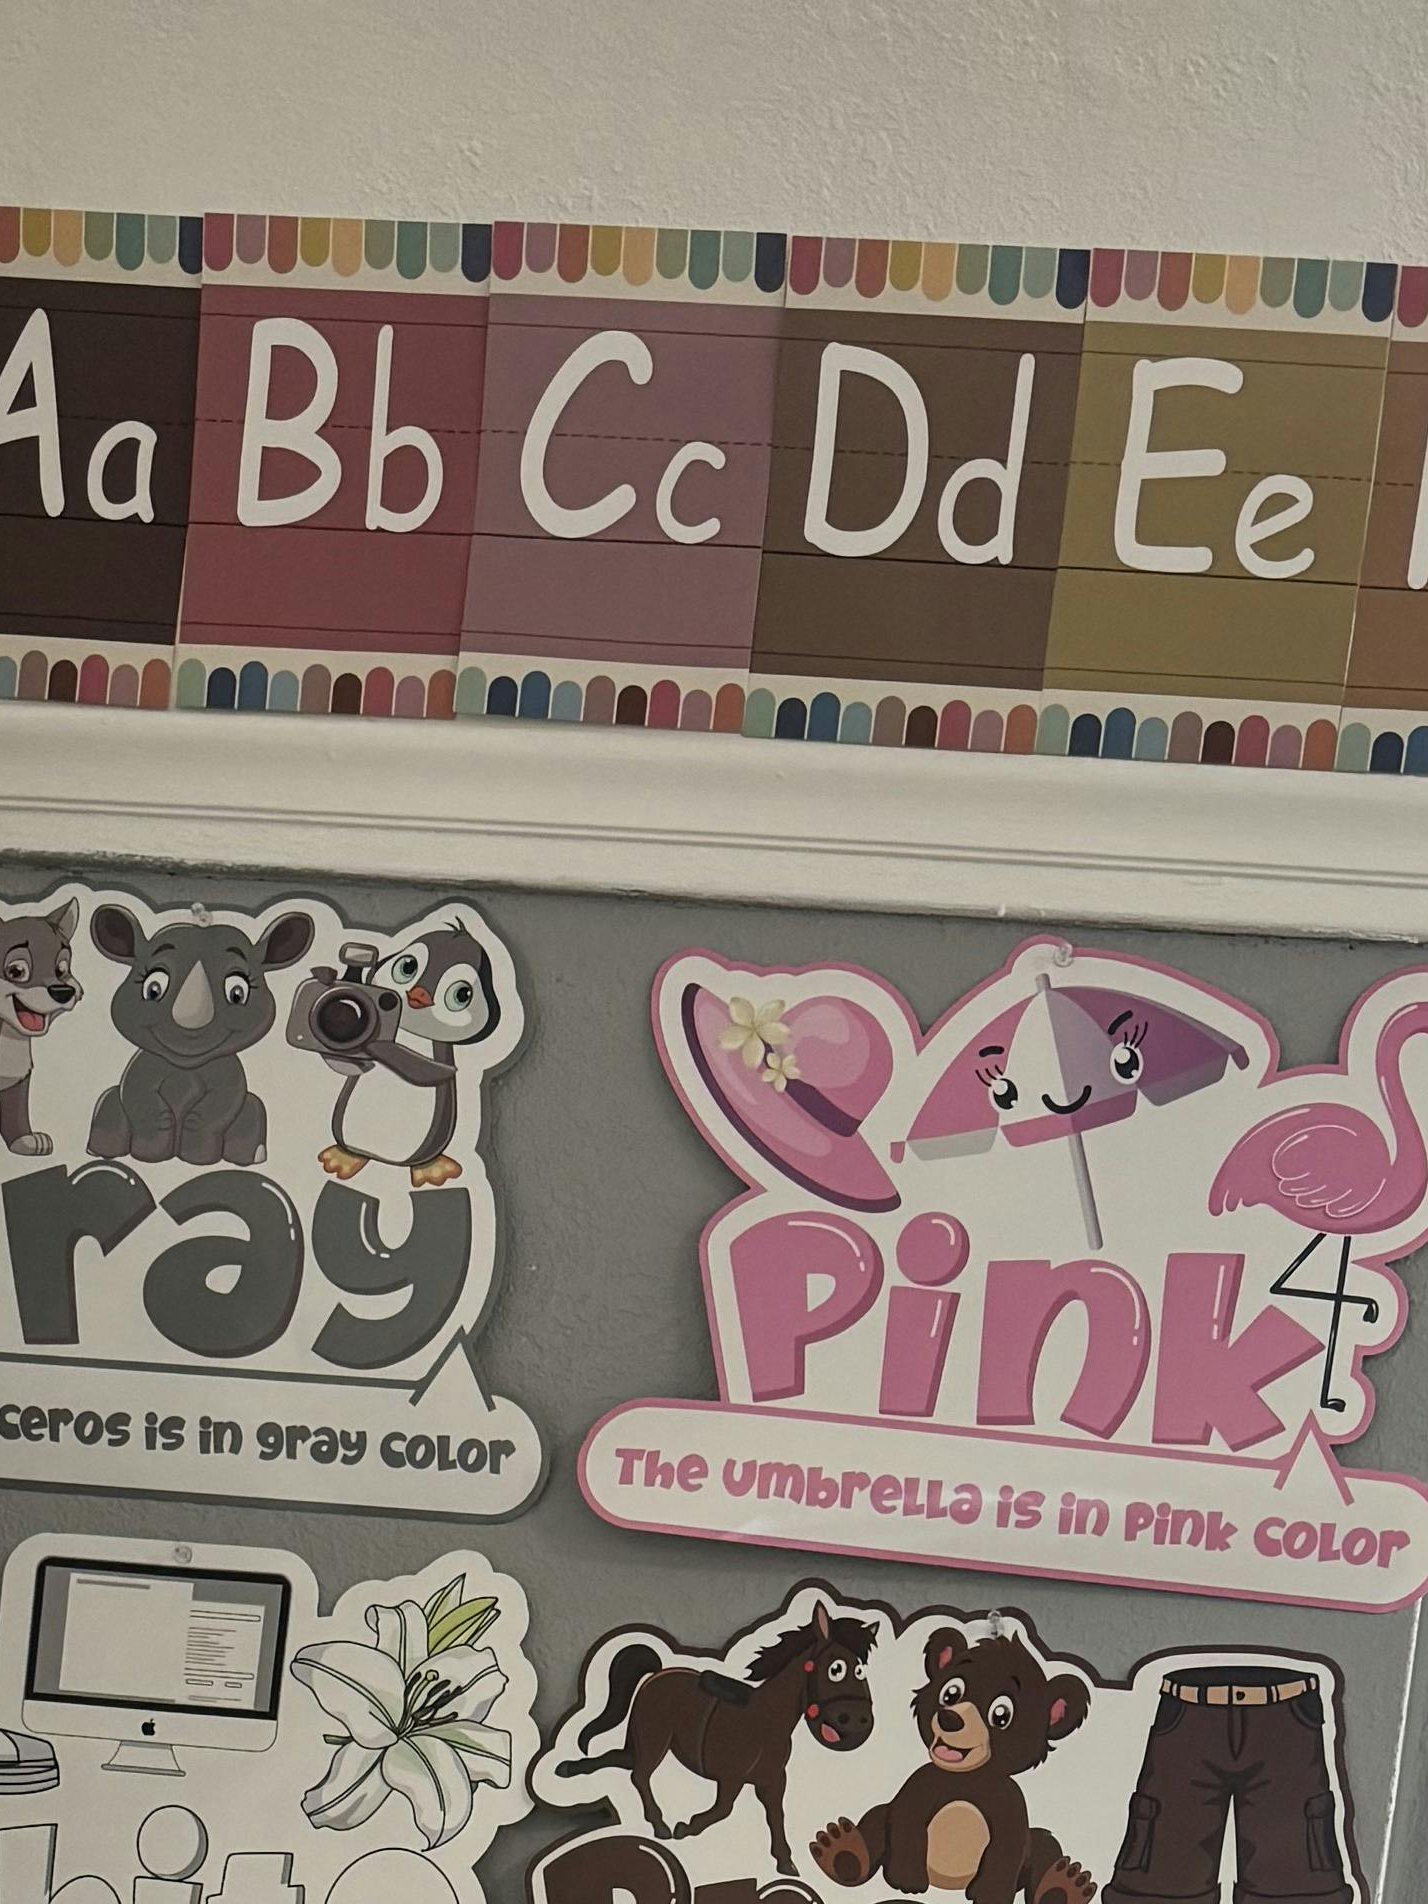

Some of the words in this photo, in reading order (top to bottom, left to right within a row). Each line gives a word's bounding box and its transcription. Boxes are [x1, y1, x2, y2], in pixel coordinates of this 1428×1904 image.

[236, 317, 445, 534] Bb
[519, 329, 726, 545] Cc
[803, 341, 1035, 565] Dd
[1113, 356, 1315, 579] Ee
[729, 1210, 1325, 1453] Pink
[145, 1412, 185, 1453] is
[198, 1415, 243, 1459] in
[257, 1423, 367, 1470] gray
[614, 1447, 709, 1494] The
[997, 1484, 1043, 1531] is
[1058, 1491, 1109, 1538] in
